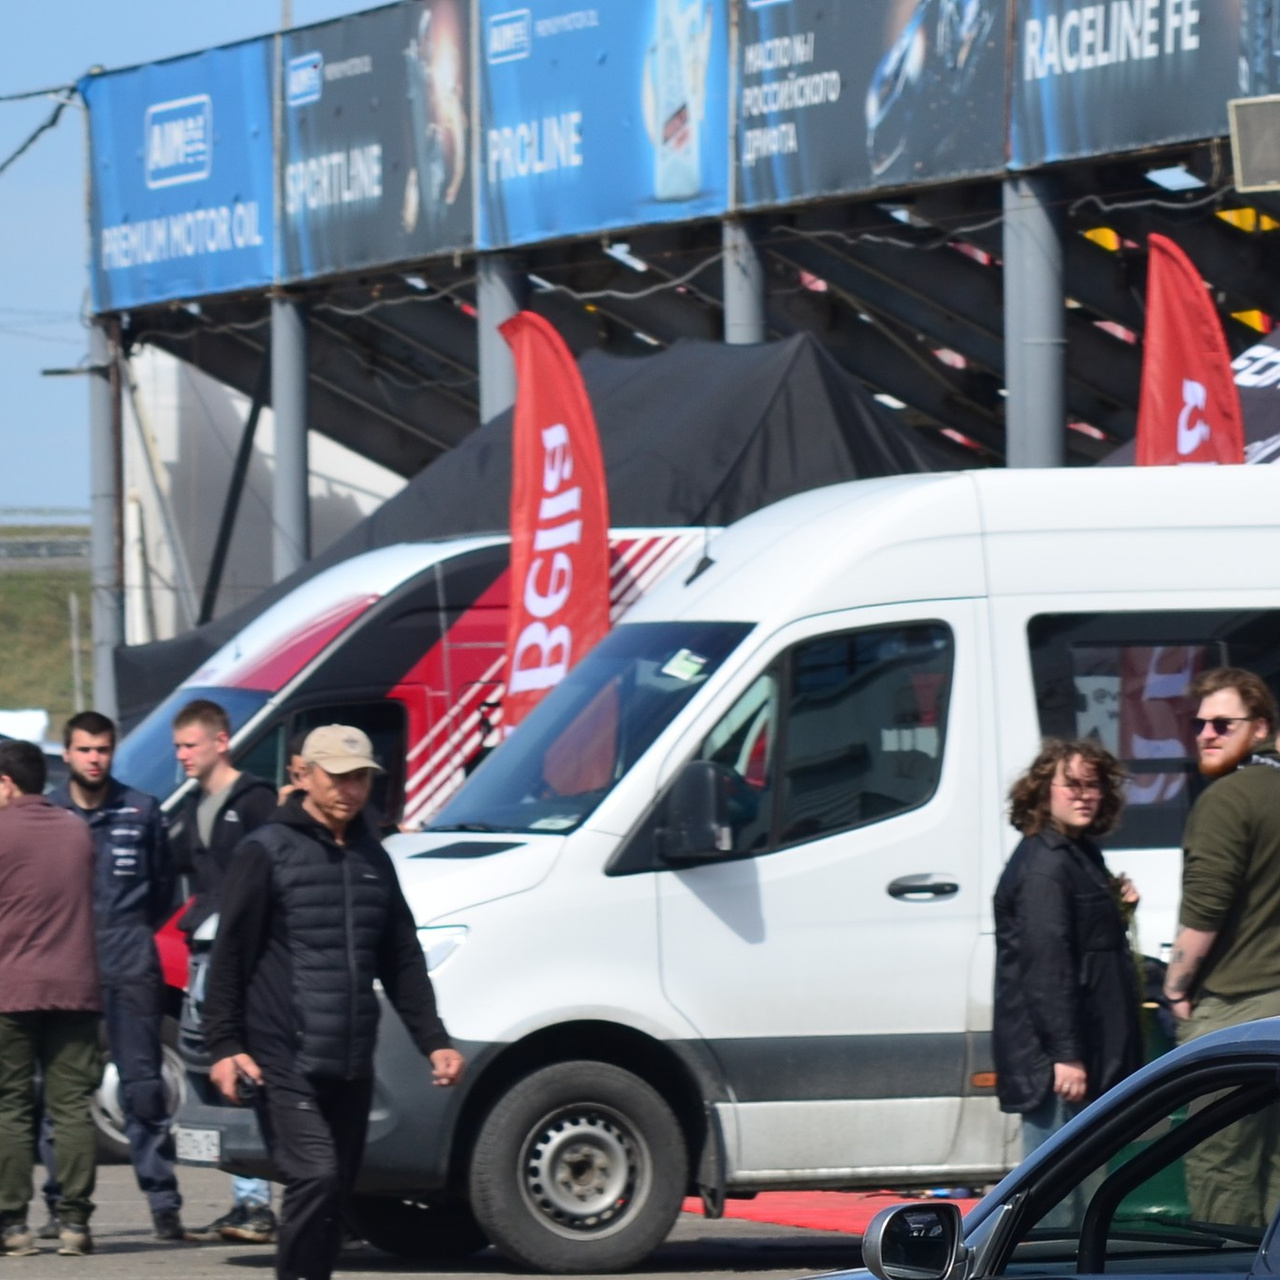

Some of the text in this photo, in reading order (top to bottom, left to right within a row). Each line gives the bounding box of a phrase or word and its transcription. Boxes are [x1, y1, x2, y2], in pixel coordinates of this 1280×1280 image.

[1024, 0, 1160, 81] RACELINE
[743, 70, 841, 118] РОССИЙСКОГО
[286, 144, 382, 214] SPORTLINE
[487, 111, 583, 183] PROLINE
[102, 201, 263, 270] PREMIUM MOTOR OIL
[508, 423, 583, 695] Bella
